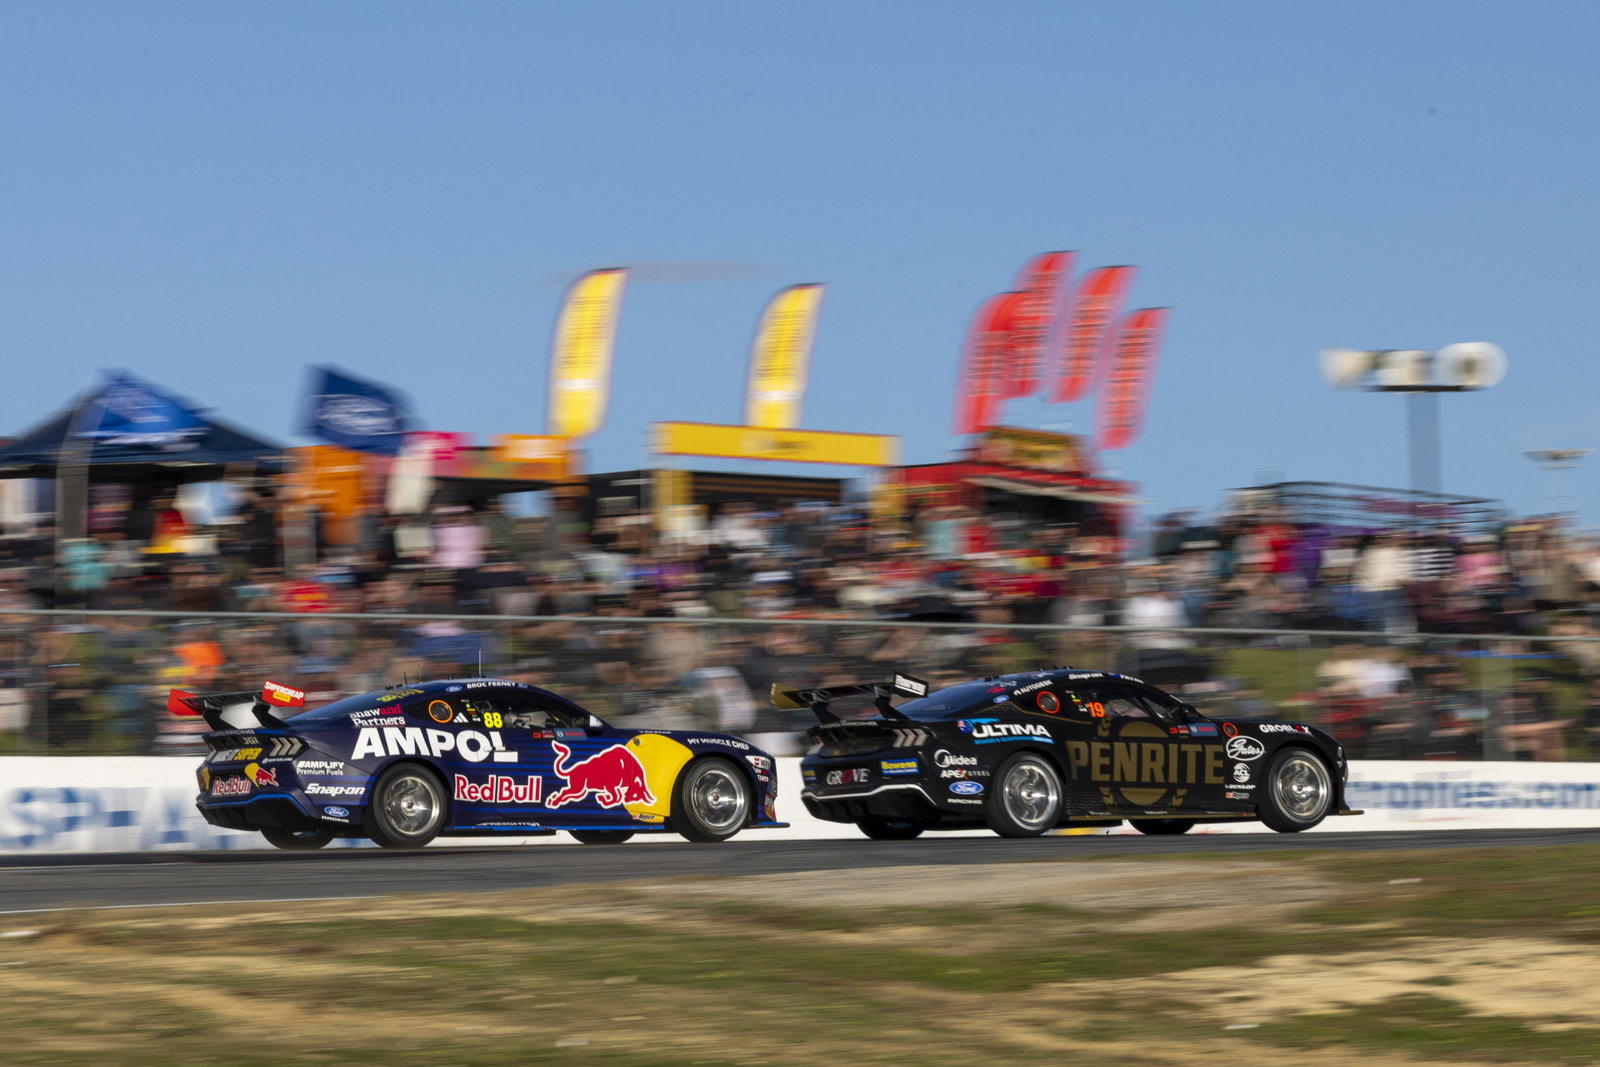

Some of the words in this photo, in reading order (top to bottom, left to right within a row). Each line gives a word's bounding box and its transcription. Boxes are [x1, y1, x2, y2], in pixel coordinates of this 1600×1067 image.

[264, 680, 304, 700] SUPERCHEAP
[1088, 701, 1105, 718] 19
[353, 716, 406, 727] Partners
[484, 712, 503, 728] 88
[972, 724, 1052, 738] ULTIMA
[351, 727, 518, 762] AMPOL
[700, 738, 732, 747] MUSCLE
[731, 740, 750, 750] CHEF
[304, 761, 344, 769] AMPLIFY
[941, 754, 978, 766] Midea
[1066, 741, 1224, 784] PENRITE
[827, 768, 869, 784] GROVE
[940, 769, 968, 779] APEX
[212, 776, 230, 796] Red
[230, 776, 252, 794] Bull
[304, 783, 366, 796] Snap-on
[454, 774, 496, 802] Red
[497, 776, 542, 803] Bull
